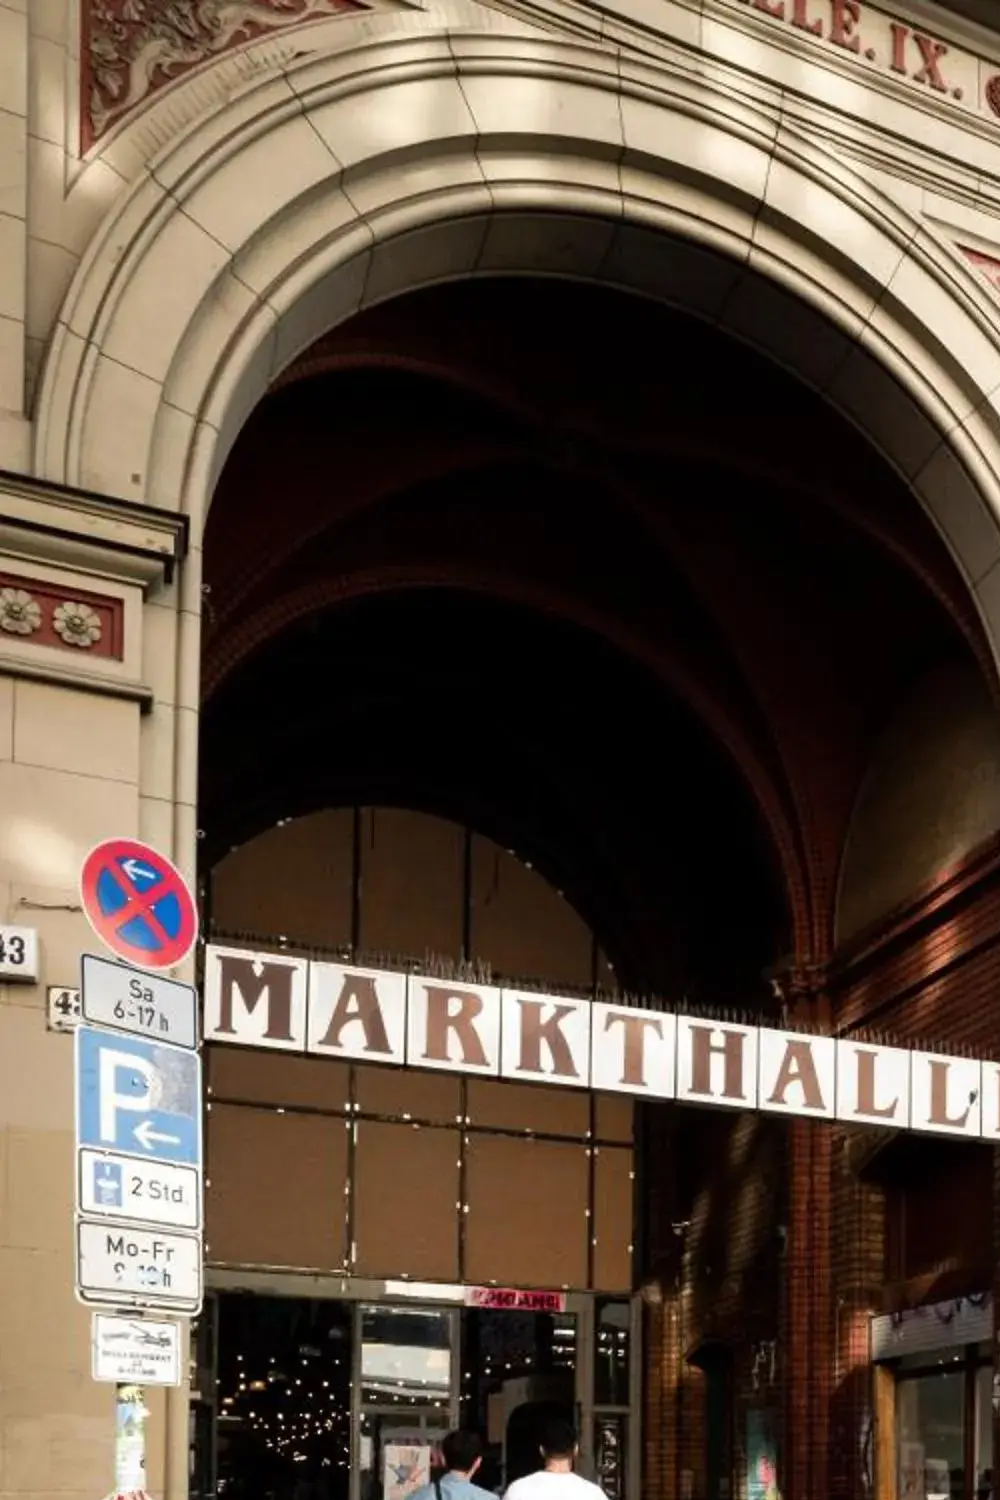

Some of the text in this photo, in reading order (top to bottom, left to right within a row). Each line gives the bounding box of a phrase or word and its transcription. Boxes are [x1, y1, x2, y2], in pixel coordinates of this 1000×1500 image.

[0, 933, 26, 965] 3
[129, 979, 154, 1002] Sa
[159, 1014, 169, 1032] h
[100, 1047, 162, 1142] P
[131, 1176, 144, 1197] 2
[106, 1235, 175, 1262] Mo-Fr
